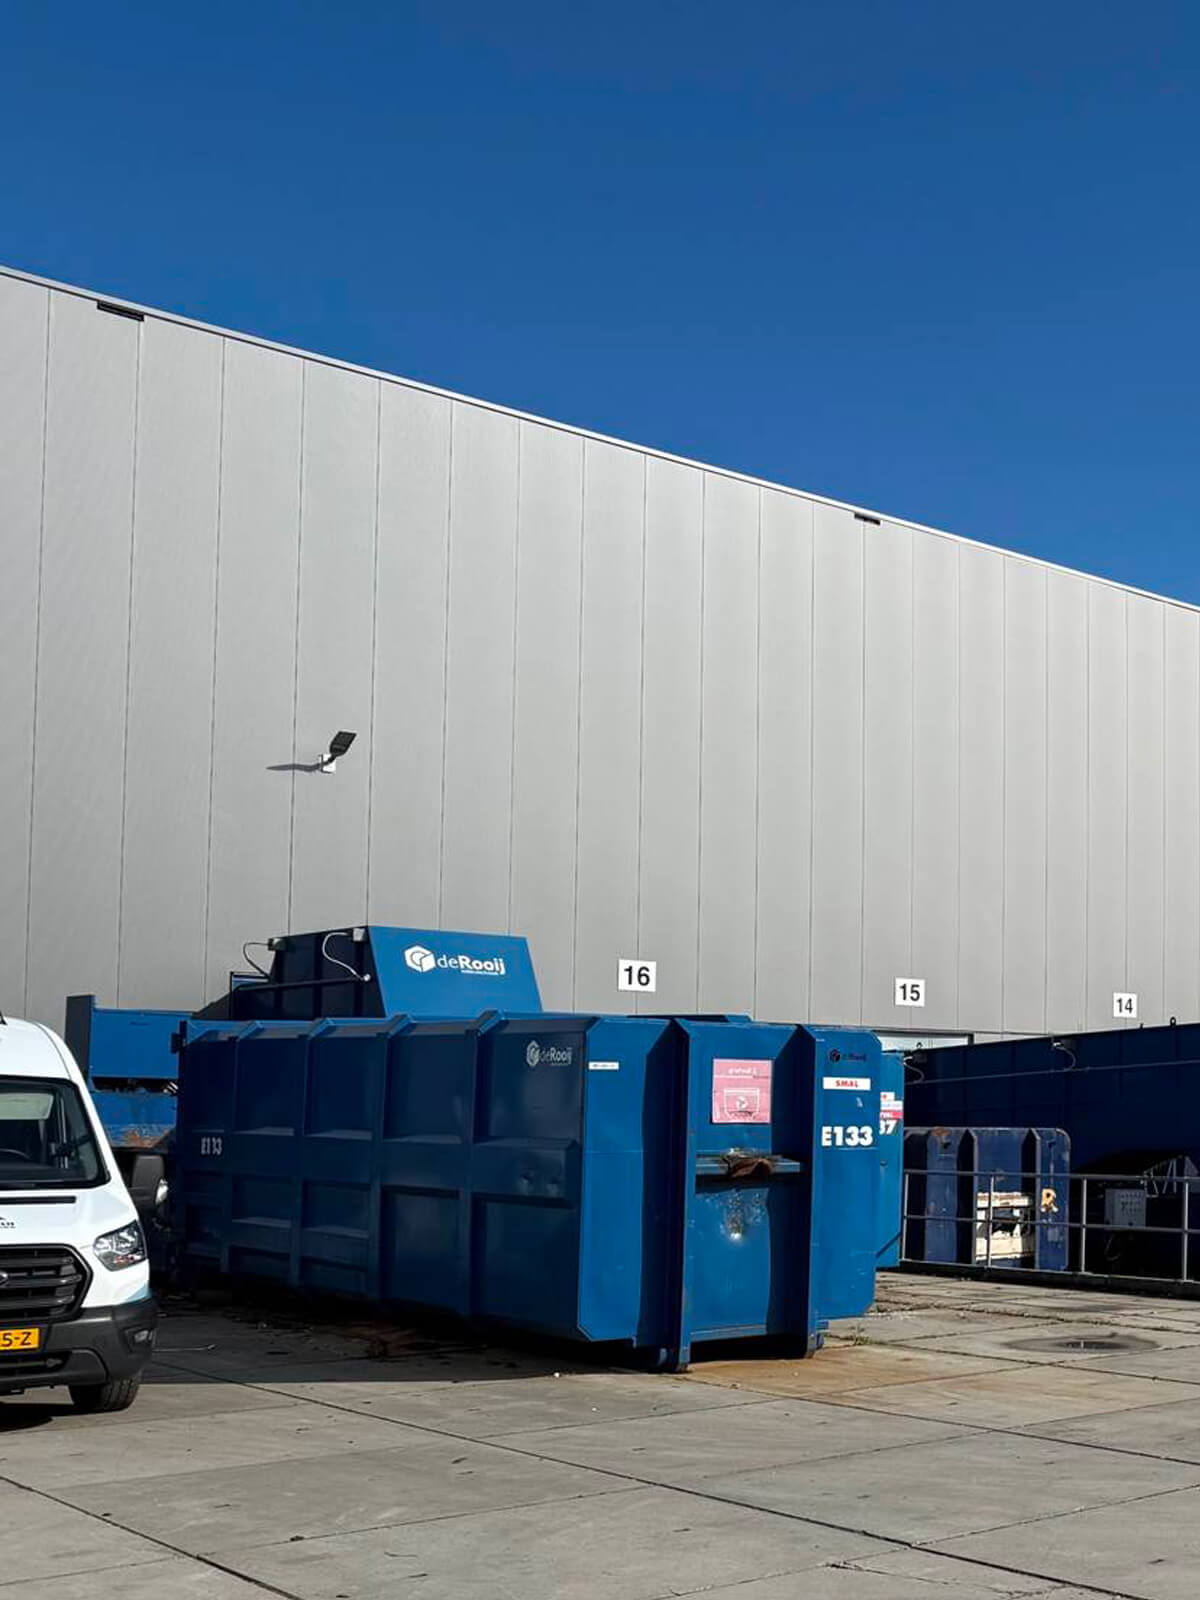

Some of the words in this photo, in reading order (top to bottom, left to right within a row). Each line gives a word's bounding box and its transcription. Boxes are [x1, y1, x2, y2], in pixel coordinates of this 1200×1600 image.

[437, 954, 506, 975] deRooij
[624, 965, 650, 986] 16
[899, 983, 921, 1001] 15
[1116, 998, 1133, 1014] 14
[821, 1125, 873, 1147] E133
[2, 1331, 32, 1347] 5-Z
